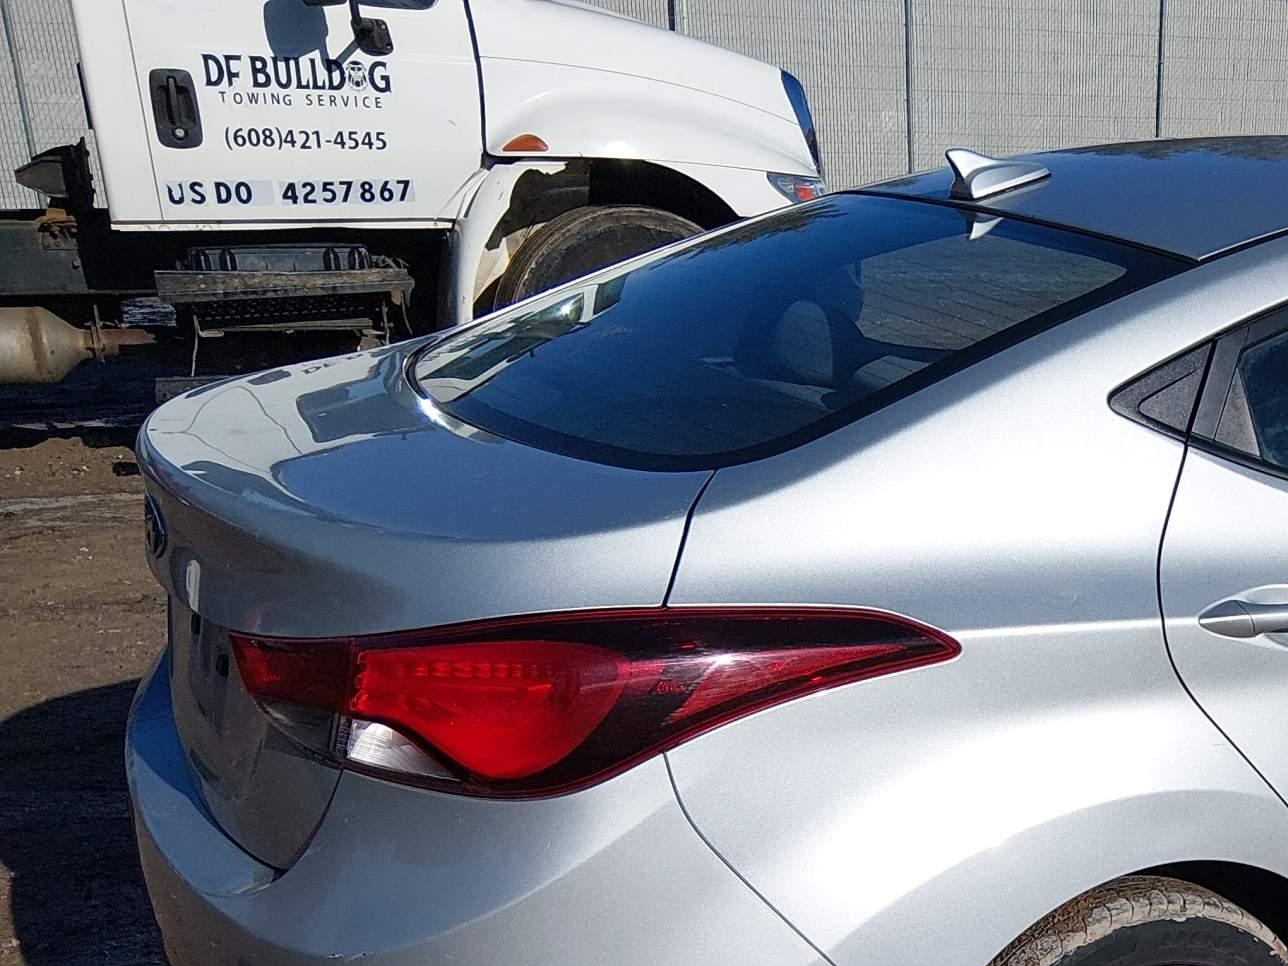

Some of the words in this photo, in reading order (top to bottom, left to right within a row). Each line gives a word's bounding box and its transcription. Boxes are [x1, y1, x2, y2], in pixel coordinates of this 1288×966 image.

[201, 54, 242, 88] DF
[219, 91, 292, 106] TOWING
[305, 94, 383, 109] SERVICE
[225, 127, 388, 151] (608)421-4545
[281, 180, 411, 205] 4257867
